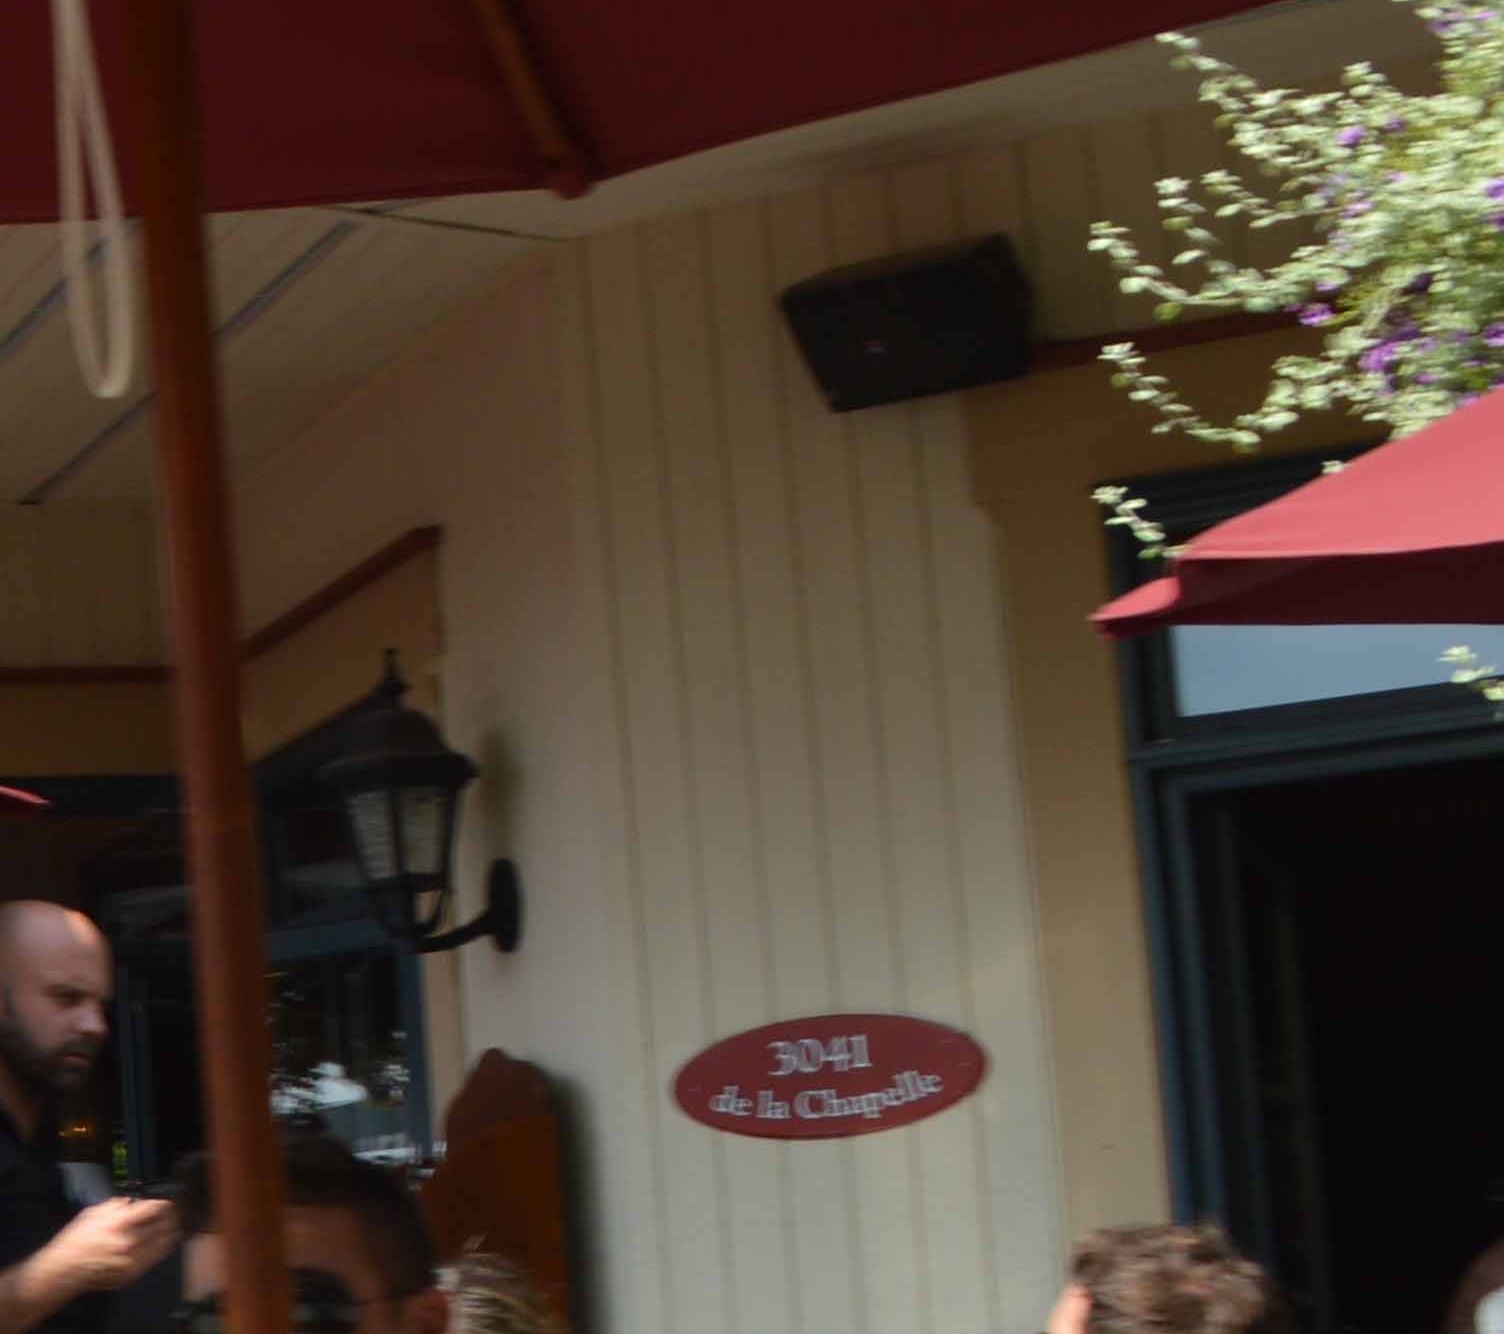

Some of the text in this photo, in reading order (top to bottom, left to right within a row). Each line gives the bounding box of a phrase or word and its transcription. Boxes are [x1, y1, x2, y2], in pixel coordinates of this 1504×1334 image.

[766, 1034, 873, 1076] 3041
[708, 1069, 945, 1120] de la Chapelle
